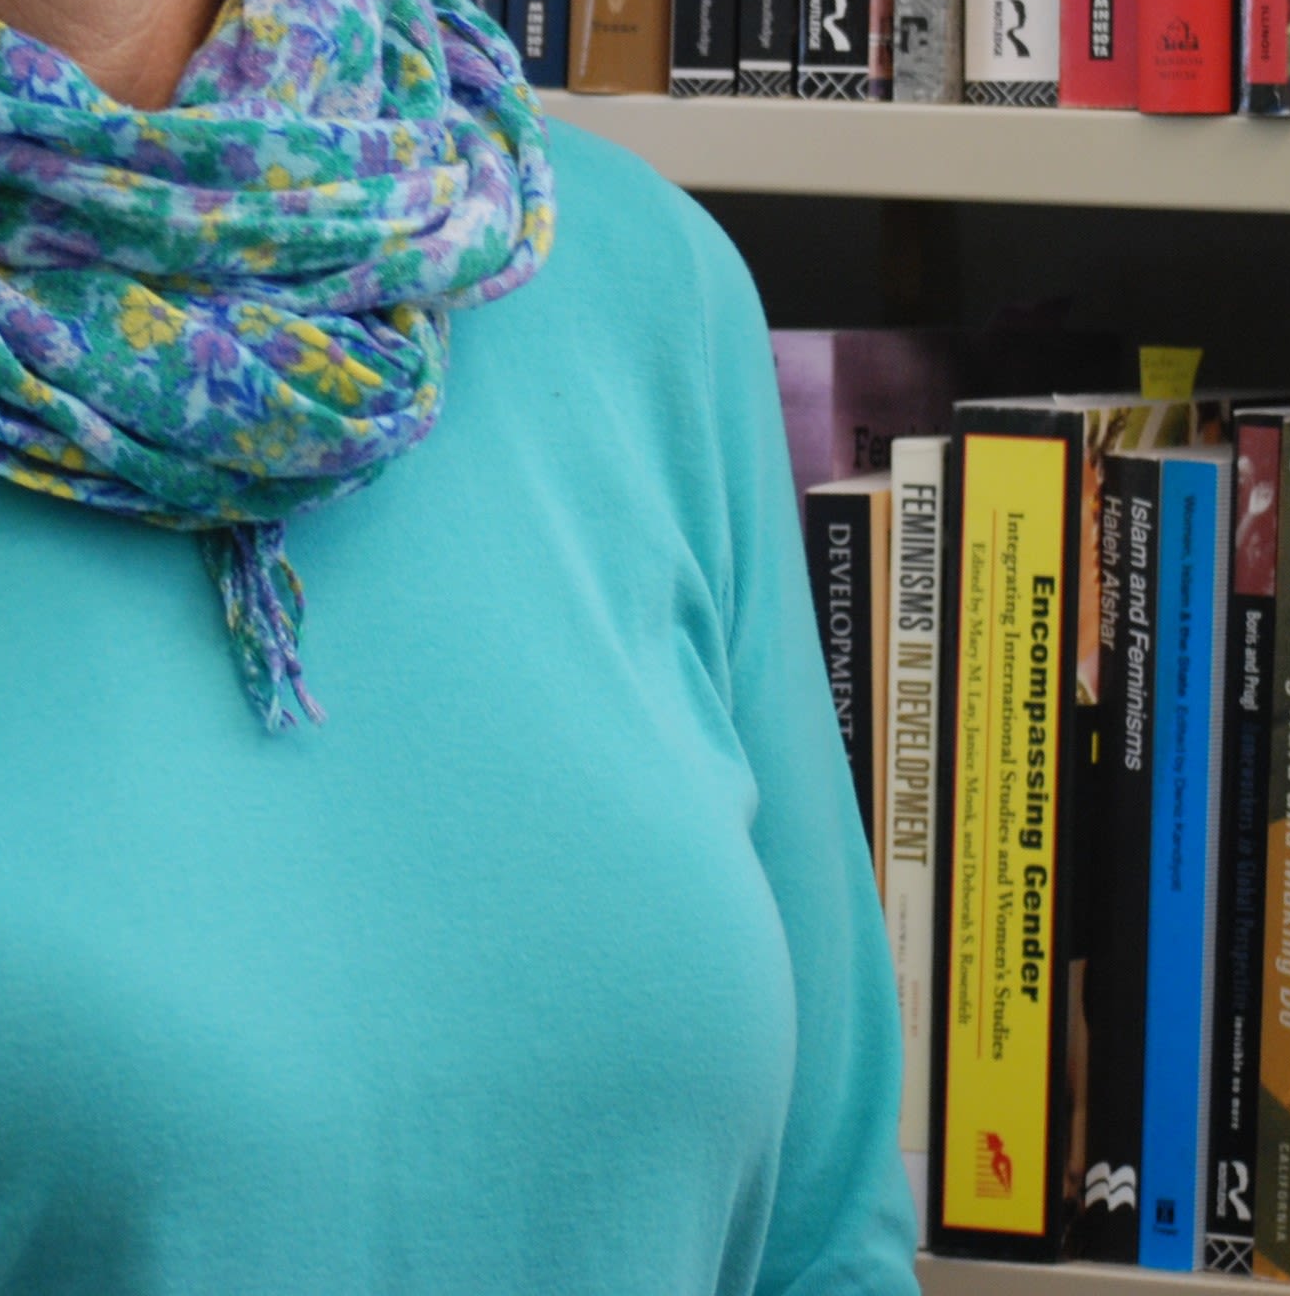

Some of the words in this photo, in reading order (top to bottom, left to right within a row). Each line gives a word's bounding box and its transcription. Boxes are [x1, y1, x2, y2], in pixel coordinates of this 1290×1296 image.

[898, 484, 935, 631] FEMINISMS
[998, 512, 1023, 626] Integrating
[1100, 496, 1123, 562] Haleh
[1126, 498, 1151, 569] Islam
[1099, 570, 1121, 649] Afshar
[1126, 576, 1148, 625] and
[897, 642, 928, 668] IN
[998, 632, 1020, 764] International
[1020, 575, 1056, 850] Encompassing
[1123, 632, 1148, 769] Feminisms
[892, 680, 928, 866] DEVELOPMENT
[995, 771, 1018, 844] Studies
[997, 850, 1015, 884] and
[1017, 864, 1048, 1002] Gender
[993, 986, 1011, 1061] Studies
[1275, 1143, 1290, 1243] CALIFORNIA
